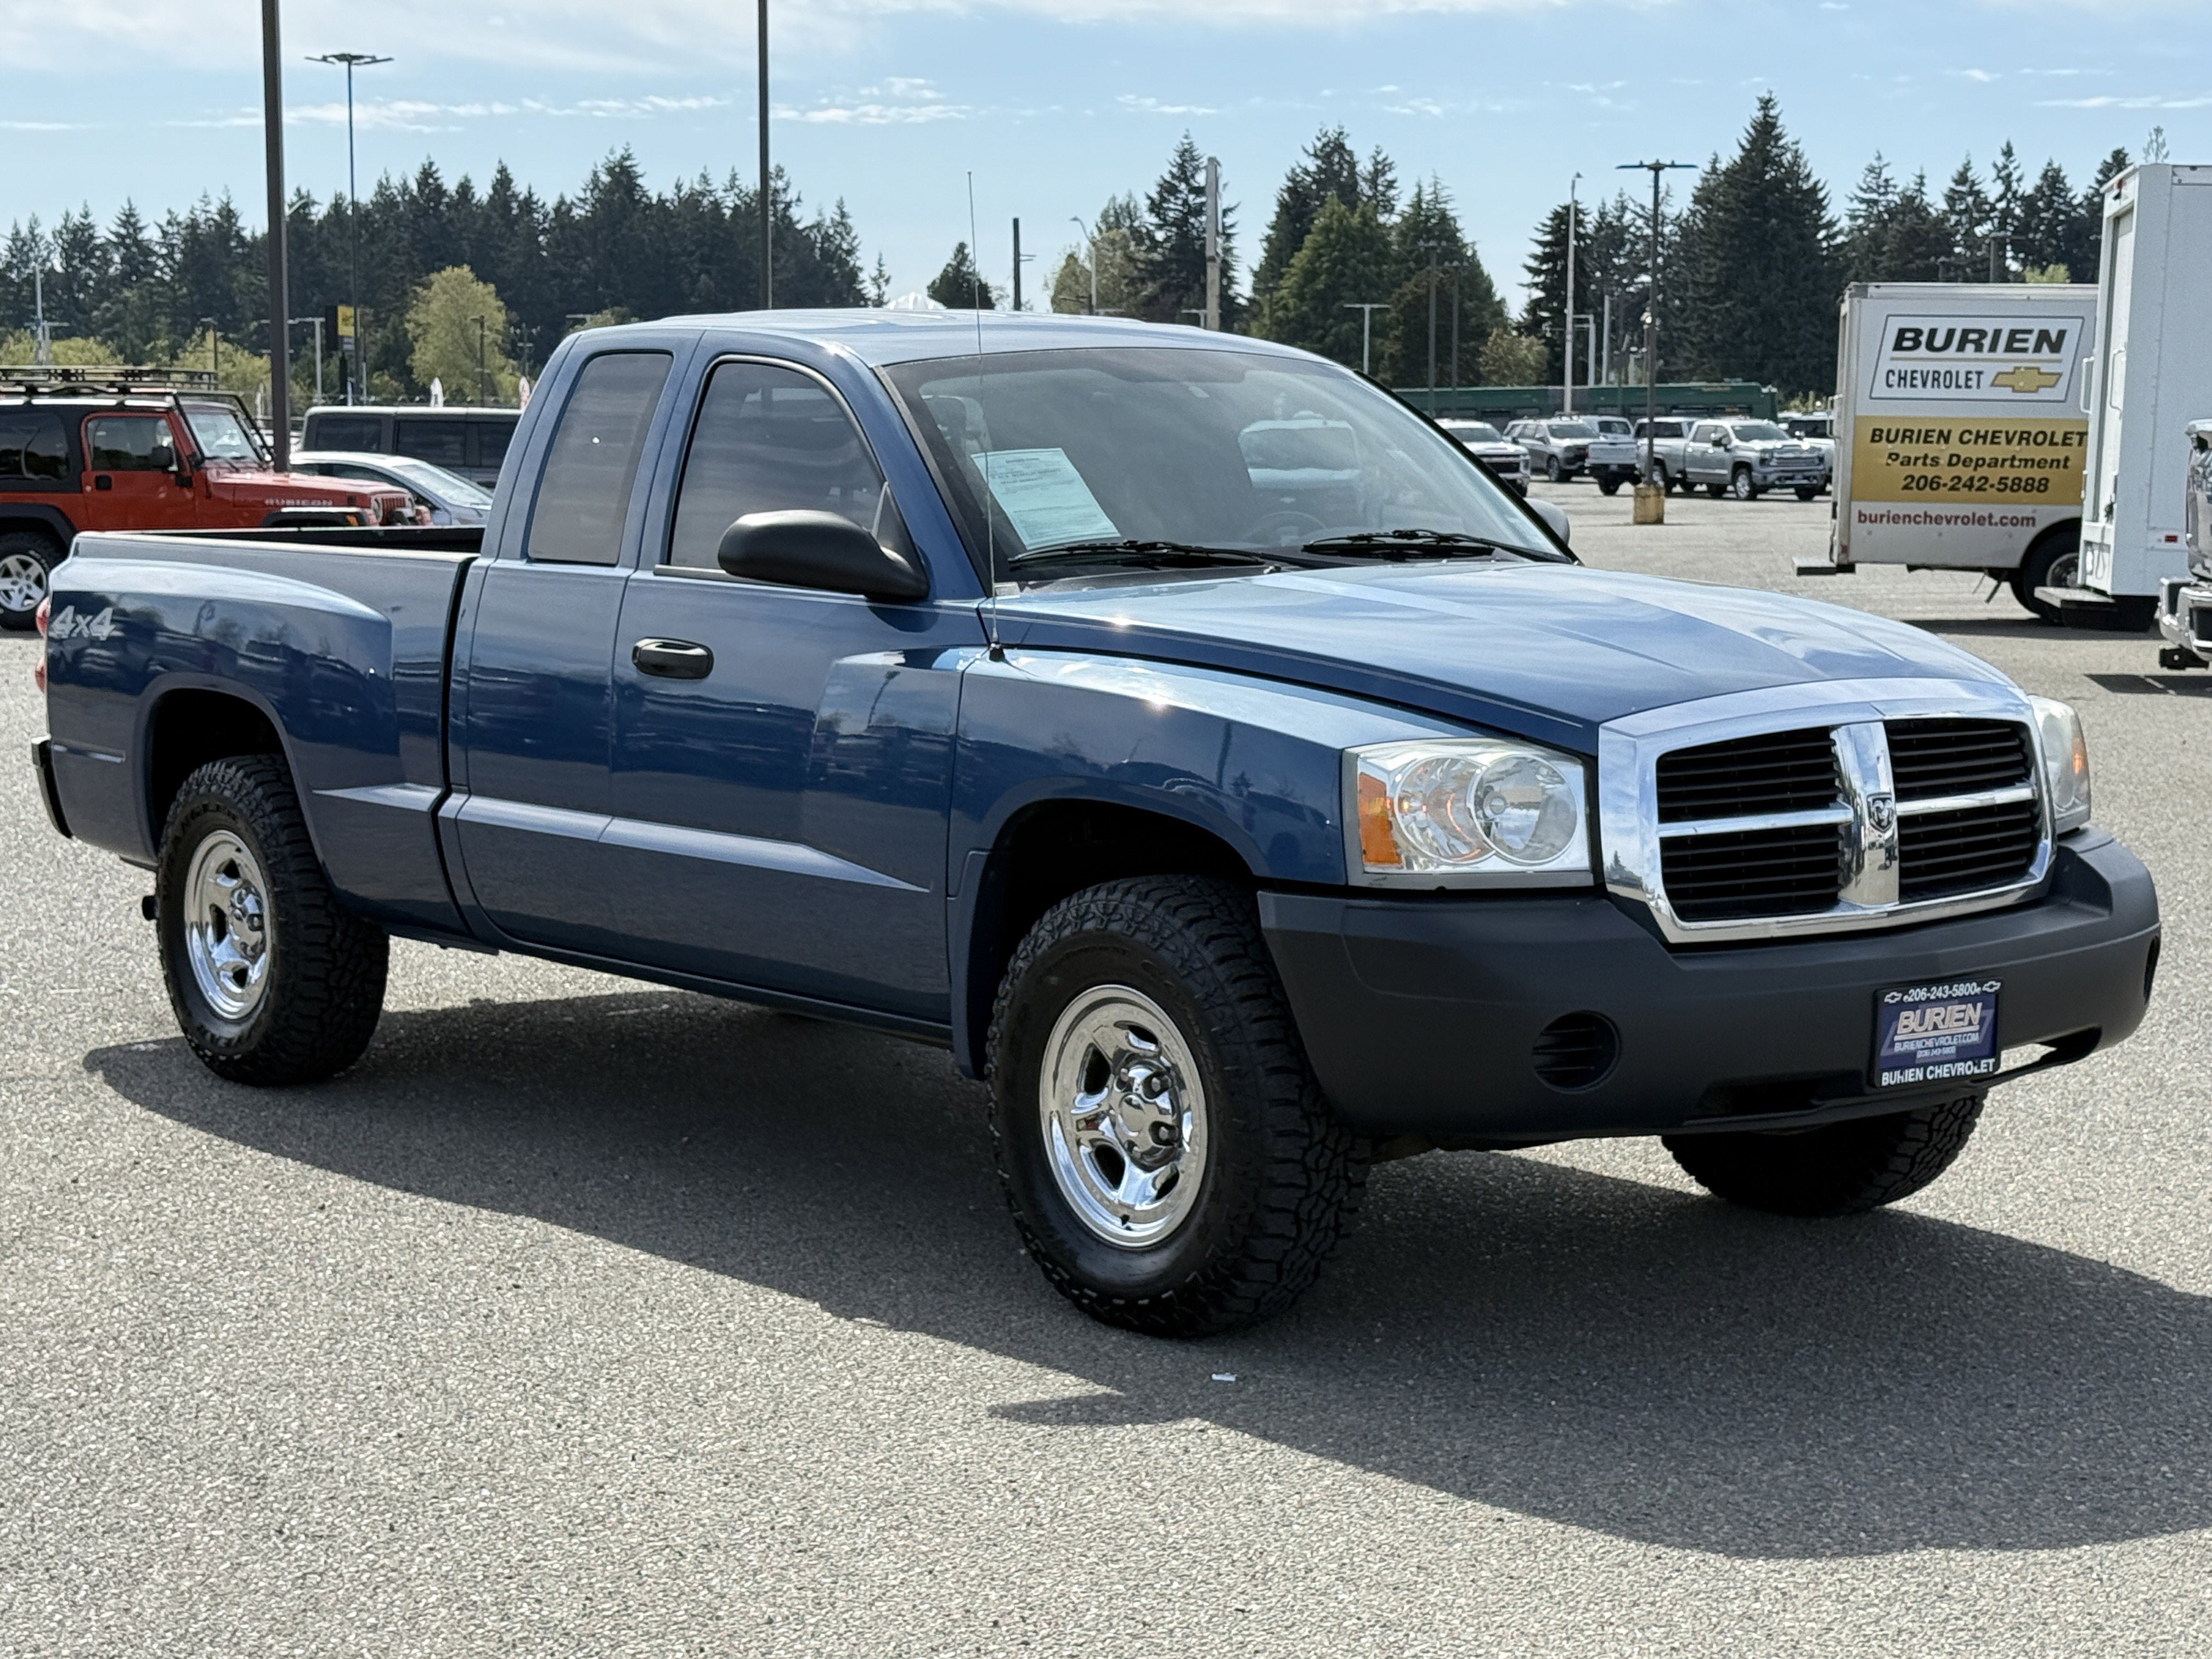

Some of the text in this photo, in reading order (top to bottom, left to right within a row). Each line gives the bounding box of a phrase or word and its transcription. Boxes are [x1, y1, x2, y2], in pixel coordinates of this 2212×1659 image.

[1892, 328, 2067, 353] BURIEN
[1886, 369, 1984, 389] CHEVROLET
[1870, 428, 2087, 447] BURIEN CHEVROLET
[1886, 453, 2070, 471] Parts Department
[1901, 475, 2050, 493] 206-242-5888
[1858, 510, 2036, 527] burienchevrolet.com
[50, 606, 116, 641] 4x4
[1897, 1002, 1983, 1034] BURIEN
[1881, 1058, 1996, 1087] BURIEN CHEVROLET
